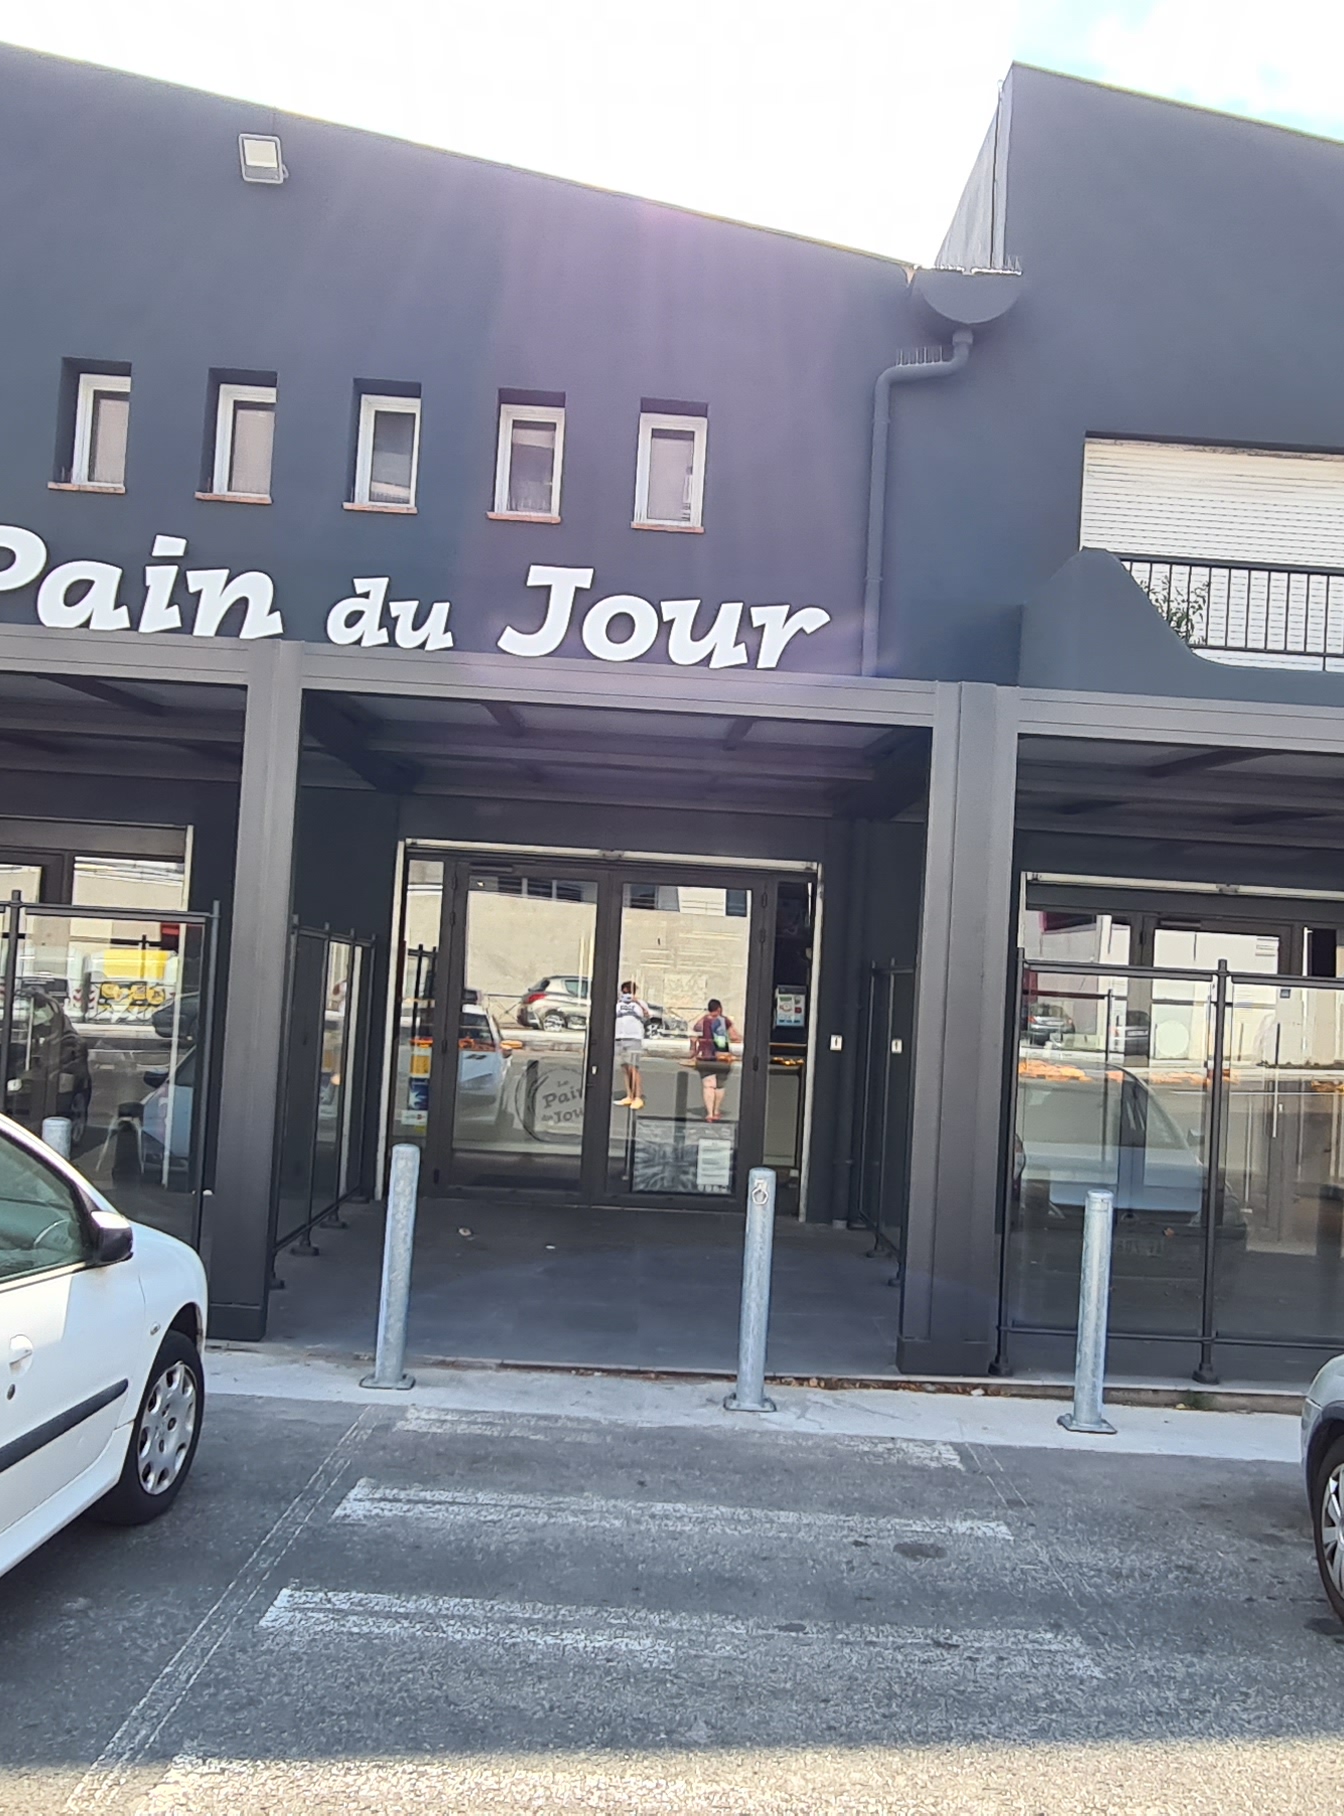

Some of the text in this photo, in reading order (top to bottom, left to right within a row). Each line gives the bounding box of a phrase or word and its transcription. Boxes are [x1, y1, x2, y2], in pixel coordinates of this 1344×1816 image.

[327, 577, 454, 651] du
[497, 565, 831, 669] Jour
[554, 1107, 584, 1122] Jou
